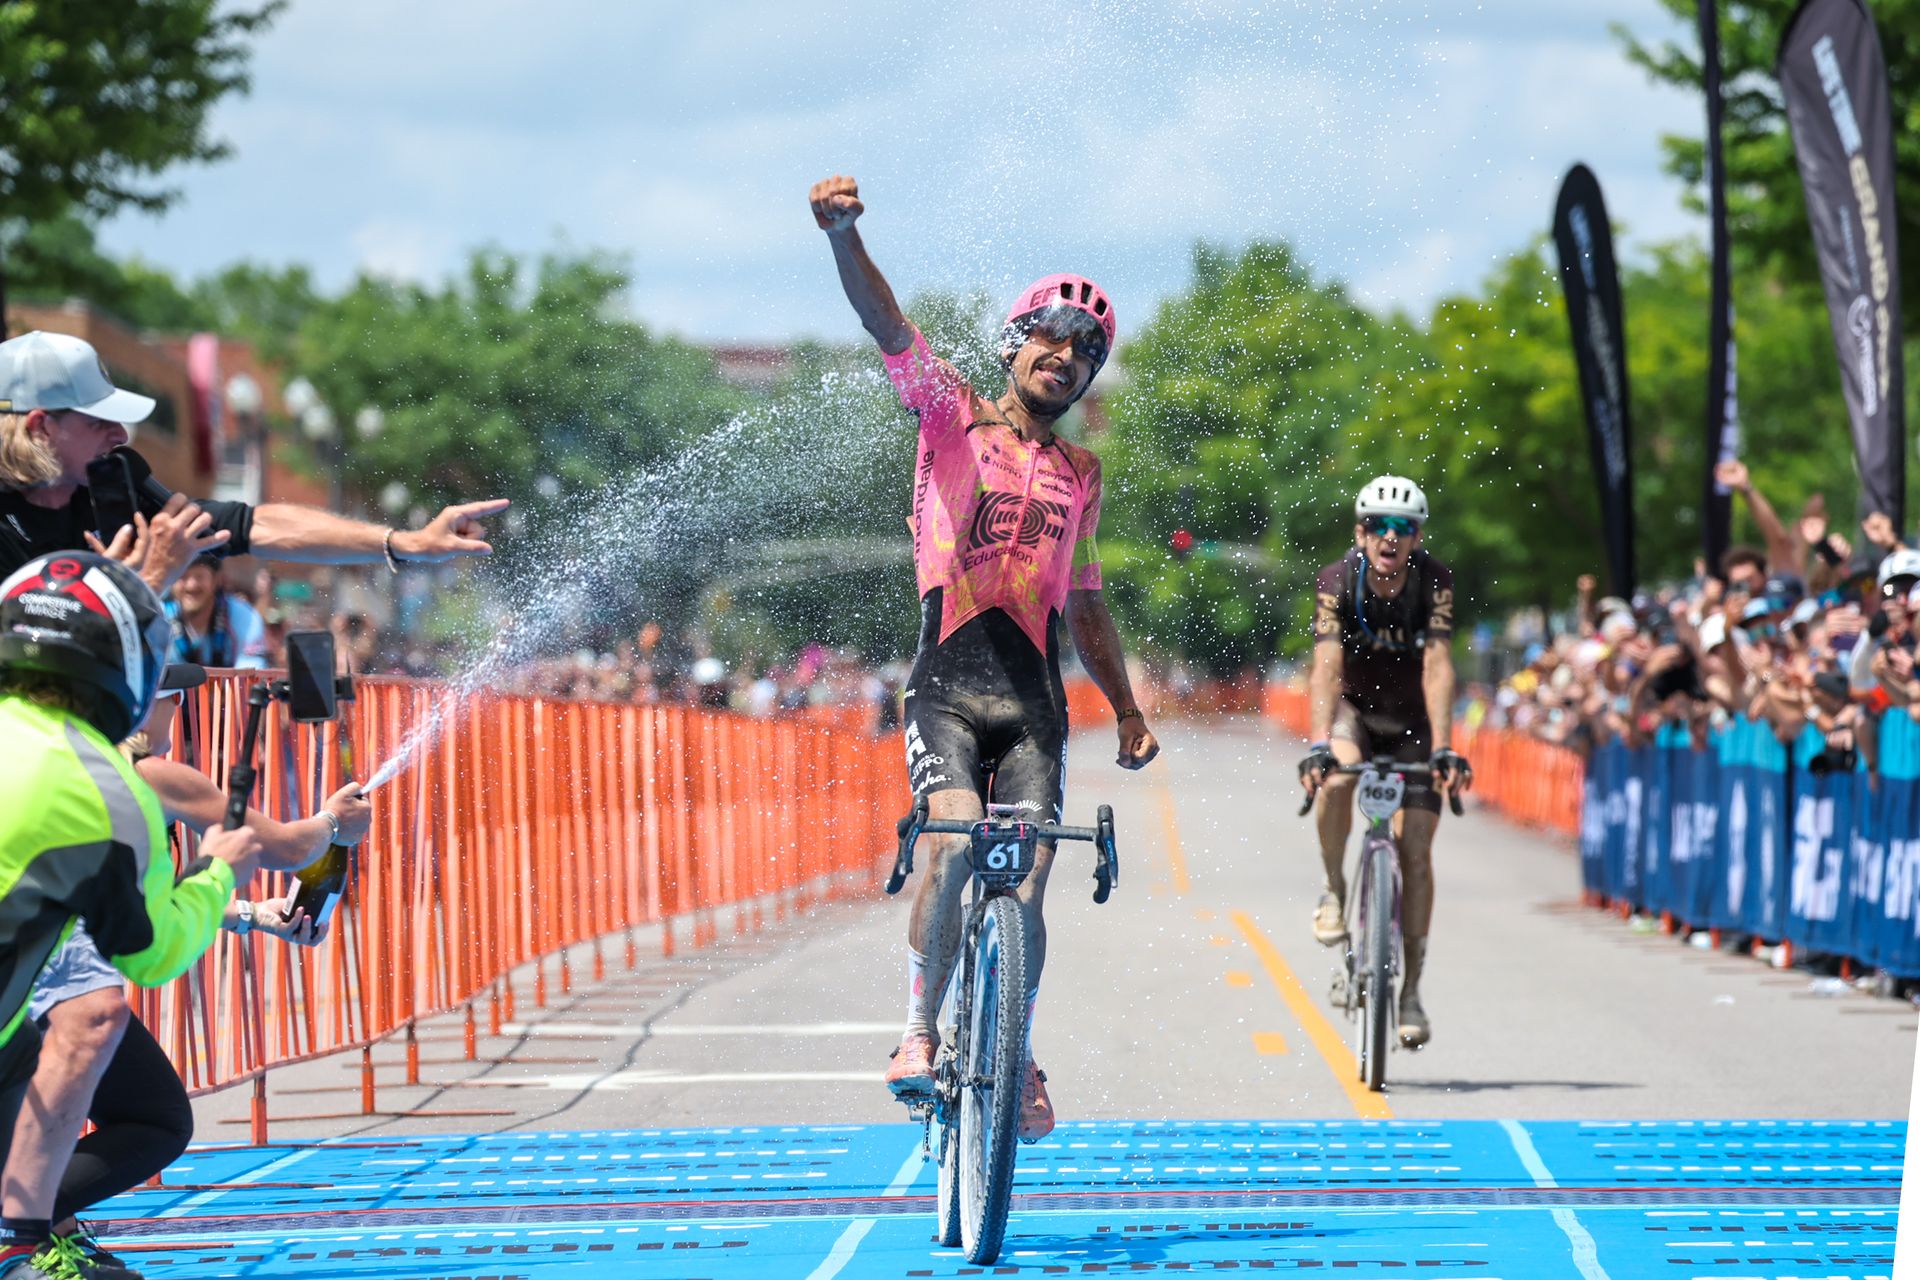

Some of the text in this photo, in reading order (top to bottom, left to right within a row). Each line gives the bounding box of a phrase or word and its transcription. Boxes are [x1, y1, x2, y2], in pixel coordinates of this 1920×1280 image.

[992, 459, 1023, 479] NIPPO
[1041, 482, 1073, 498] wahoo
[963, 545, 1034, 571] Education
[1428, 588, 1453, 631] PAS
[1364, 785, 1397, 801] 169
[987, 843, 1020, 869] 61
[1198, 1222, 1315, 1230] TIME
